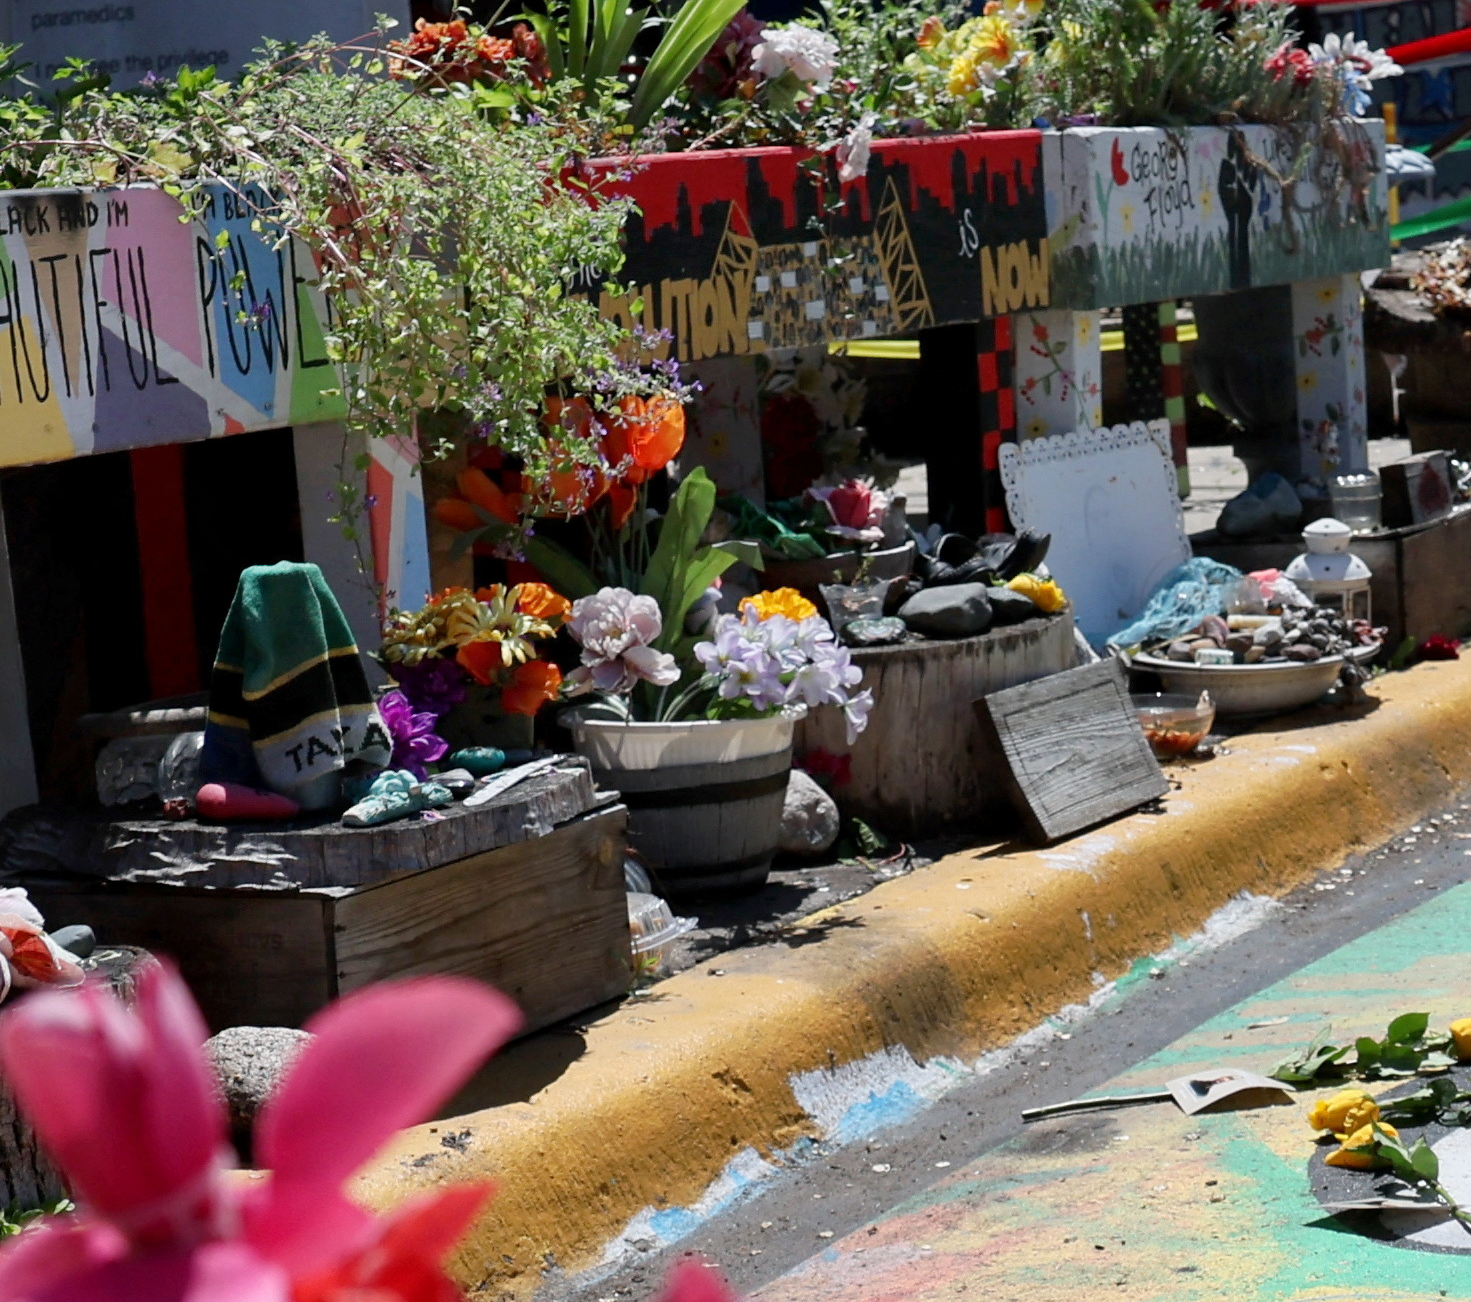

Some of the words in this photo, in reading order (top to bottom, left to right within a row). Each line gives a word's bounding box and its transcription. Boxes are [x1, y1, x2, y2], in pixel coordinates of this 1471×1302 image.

[31, 3, 135, 31] paramedics
[58, 198, 99, 230] AND
[105, 196, 130, 229] I'M
[981, 237, 1050, 316] NOW
